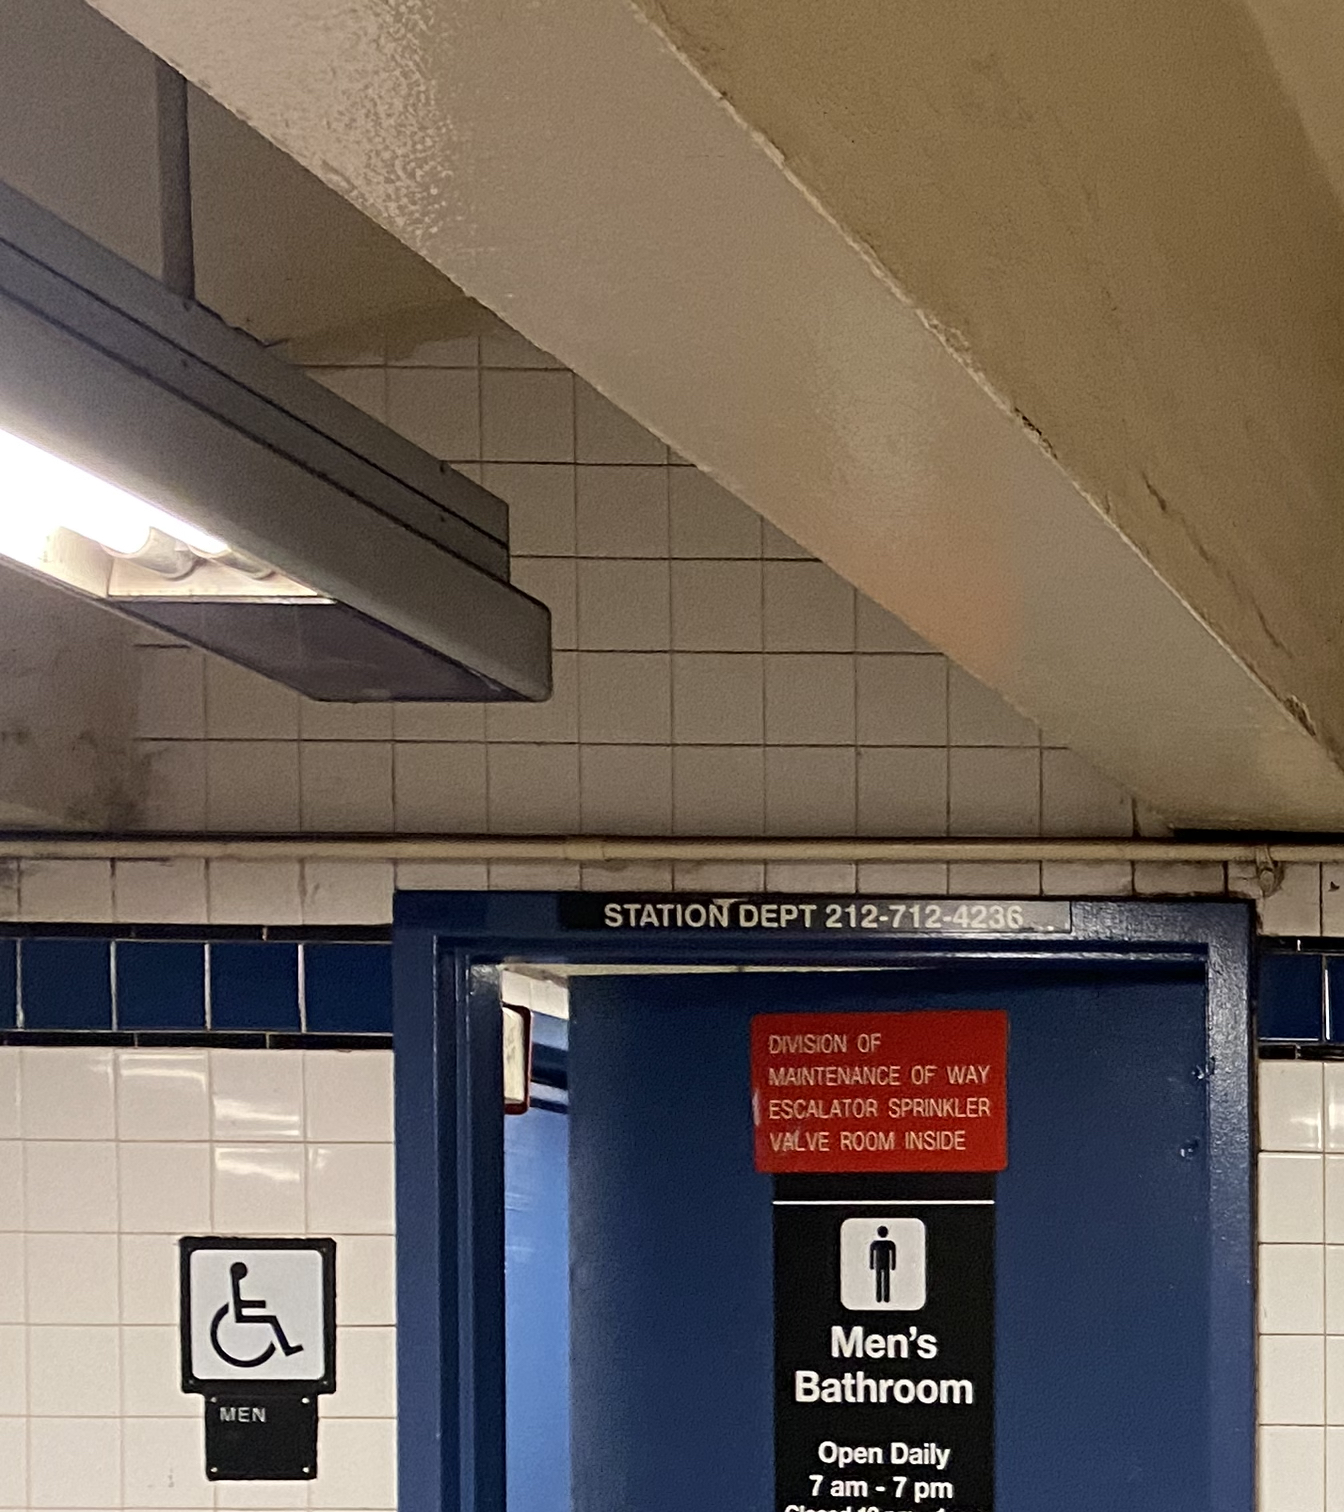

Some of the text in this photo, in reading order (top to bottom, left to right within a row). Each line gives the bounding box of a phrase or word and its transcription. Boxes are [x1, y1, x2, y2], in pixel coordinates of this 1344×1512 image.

[604, 903, 1024, 929] STATION DEPT 212-712-4236
[768, 1033, 881, 1054] DIVISION OF
[768, 1065, 991, 1086] MAINTENANCE OF WAY
[768, 1098, 991, 1120] ESCALATOR SPRINKLER
[769, 1130, 966, 1152] VALVE ROOM INSIDE
[830, 1325, 939, 1359] Men's
[794, 1370, 974, 1404] Bathroom
[220, 1406, 267, 1423] MEN
[818, 1441, 951, 1470] Open Daily
[808, 1474, 824, 1497] 7
[830, 1479, 868, 1498] am
[892, 1477, 907, 1498] 7
[914, 1480, 954, 1503] pm
